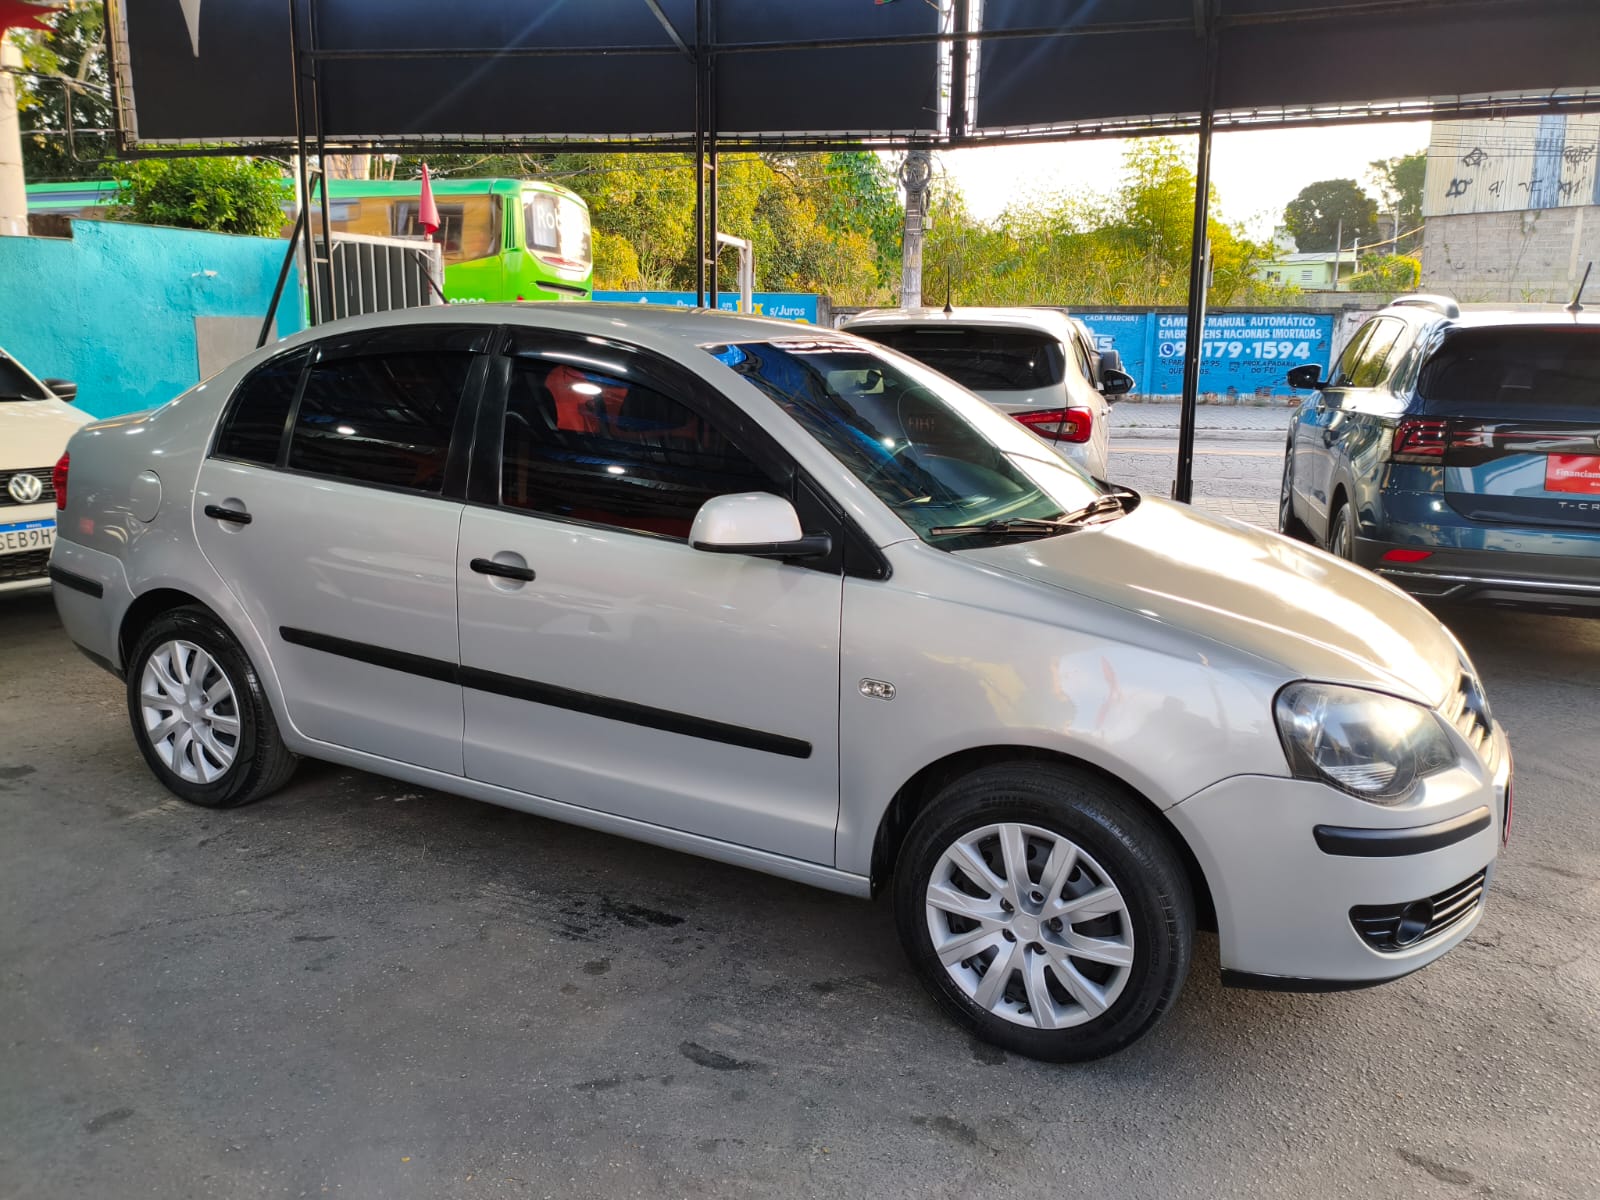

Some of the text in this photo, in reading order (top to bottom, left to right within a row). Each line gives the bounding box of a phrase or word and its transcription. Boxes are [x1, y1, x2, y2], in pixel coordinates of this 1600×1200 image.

[769, 305, 805, 317] s/Juros
[1208, 317, 1246, 327] MANUAL
[1250, 314, 1316, 327] AUTOMÁTICO
[1223, 329, 1270, 339] NACIONAIS
